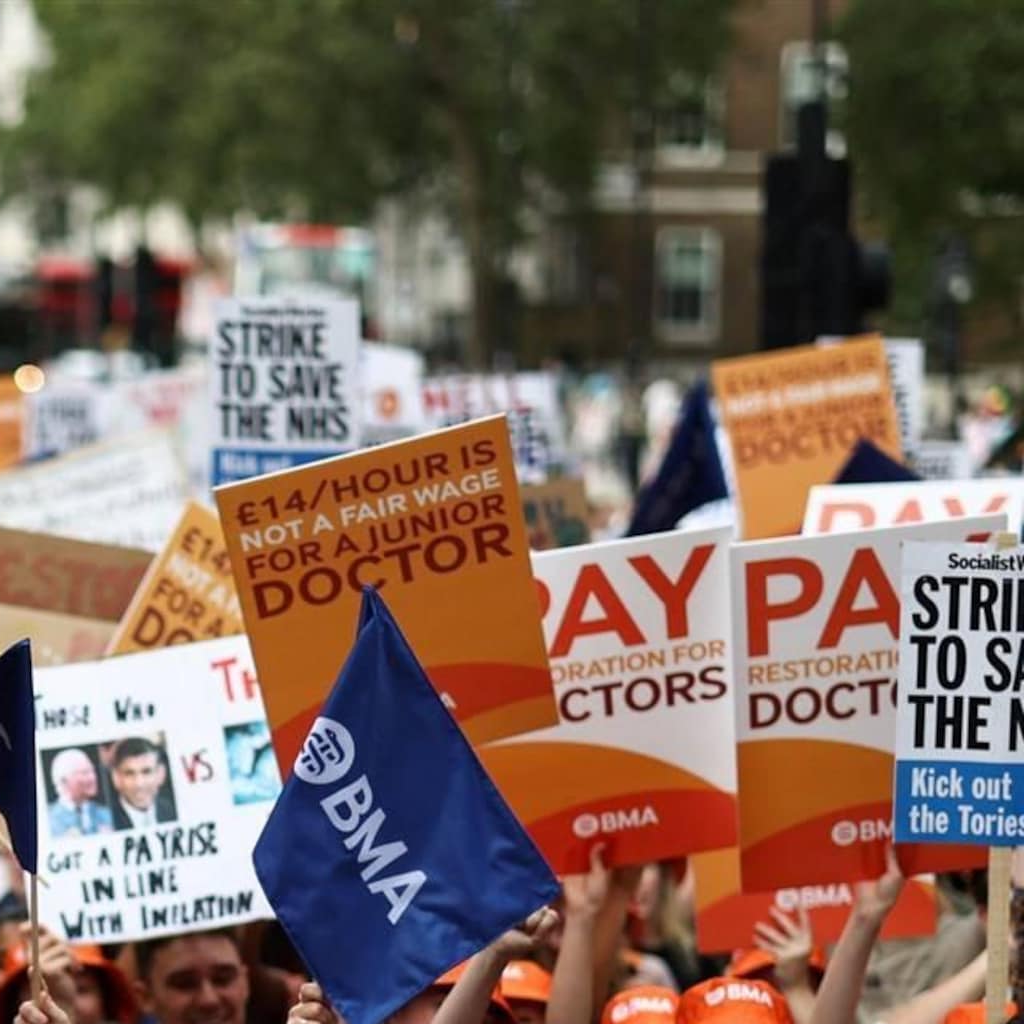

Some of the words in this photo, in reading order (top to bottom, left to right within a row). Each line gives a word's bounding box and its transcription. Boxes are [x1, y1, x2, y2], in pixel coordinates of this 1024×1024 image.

[218, 322, 324, 360] STRIKE
[219, 363, 257, 401] TO
[269, 363, 343, 400] SAVE
[219, 404, 274, 440] THE
[287, 405, 348, 441] NHS
[236, 451, 450, 527] £14/HOUR
[459, 440, 497, 470] IS
[240, 519, 305, 553] NOT
[312, 513, 335, 535] A
[339, 492, 409, 528] FAIR
[412, 468, 502, 507] WAGE
[246, 540, 324, 578] FOR
[334, 533, 364, 558] A
[365, 493, 506, 554] JUNIOR
[252, 522, 513, 619] DOCTOR
[744, 545, 902, 659] PA
[911, 575, 1024, 632] STRI
[554, 652, 666, 684] ORATION
[673, 640, 725, 665] FOR
[749, 649, 899, 684] RESTORATI
[909, 635, 967, 691] TO
[559, 666, 727, 723] CTORS
[749, 677, 898, 730] DOCT
[907, 695, 991, 751] THE
[911, 768, 963, 799] Kick
[971, 773, 1013, 800] out
[600, 806, 659, 832] BMA
[860, 819, 895, 841] BM
[908, 804, 949, 834] the
[957, 806, 1024, 838] Tories
[98, 847, 112, 866] A
[319, 772, 428, 925] BMA
[82, 876, 116, 905] IN
[125, 865, 178, 899] LINE
[59, 909, 123, 940] WITH
